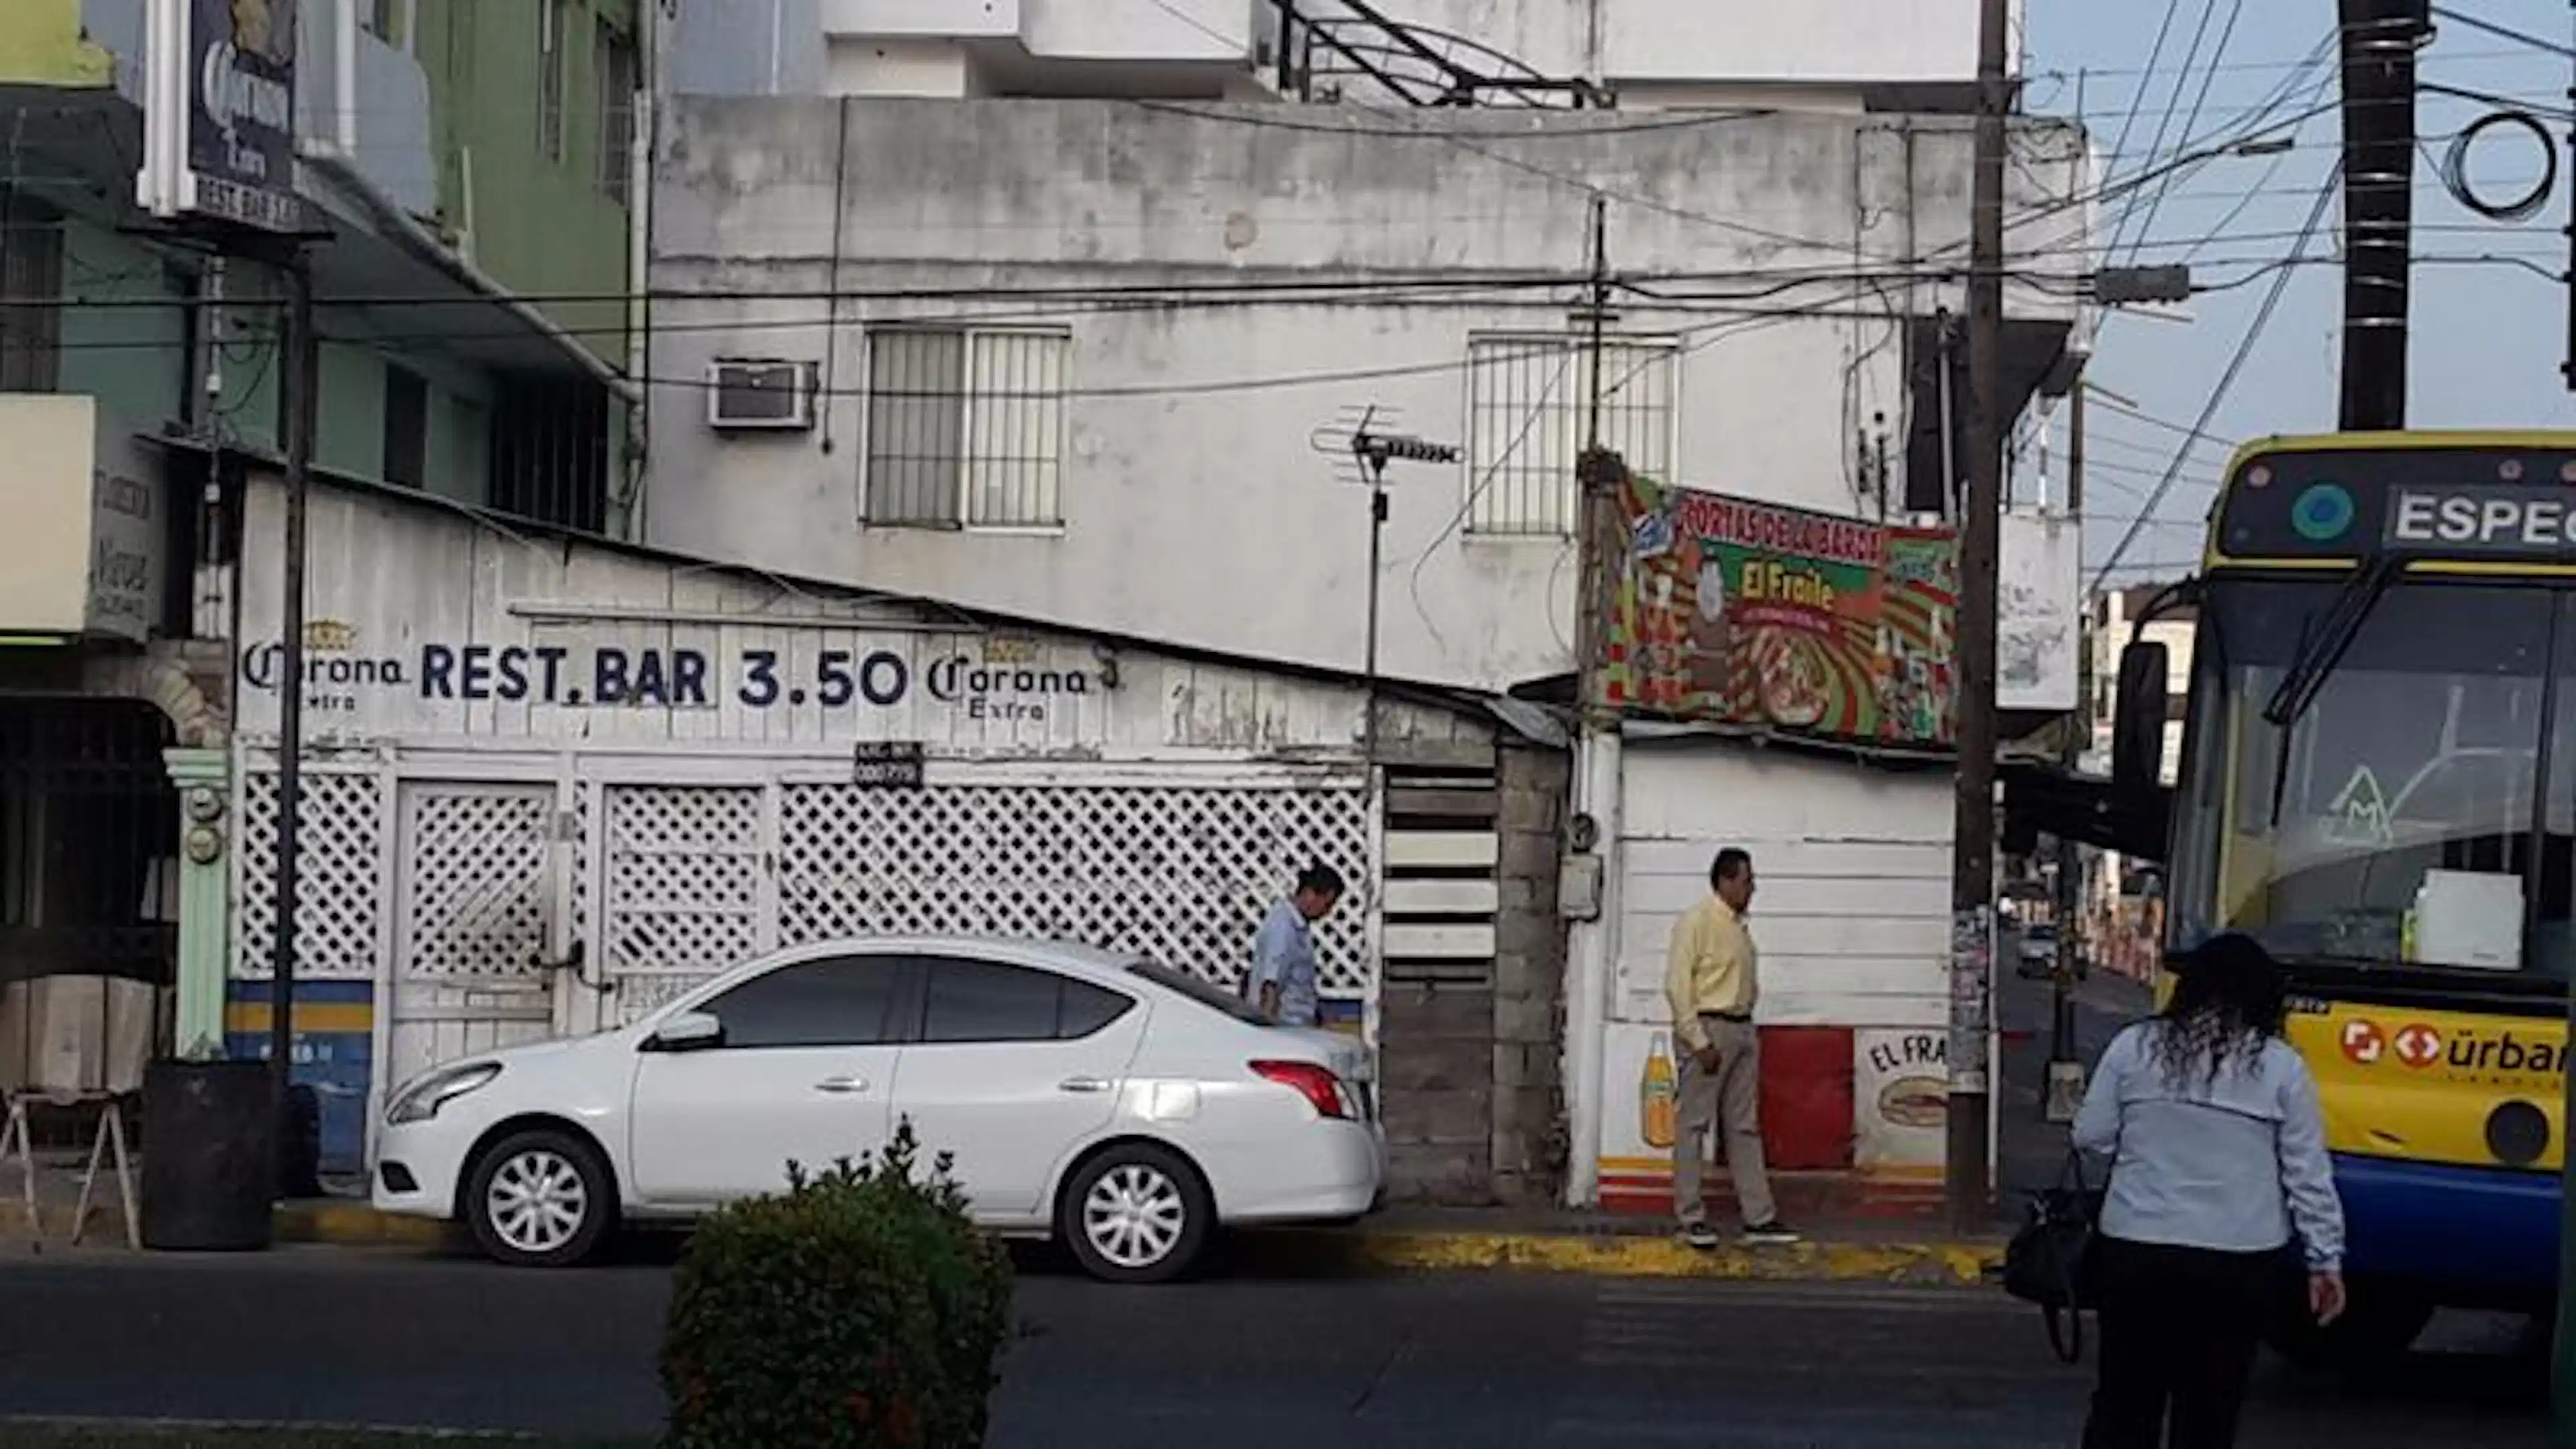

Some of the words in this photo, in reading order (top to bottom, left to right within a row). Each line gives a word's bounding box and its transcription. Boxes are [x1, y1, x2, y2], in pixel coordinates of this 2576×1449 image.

[2396, 493, 2576, 544] ESPE
[1741, 561, 1765, 598] El
[1766, 561, 1835, 611] Fraile
[243, 641, 411, 689] Crona
[596, 648, 705, 704] BAR
[739, 650, 909, 707] 3.50
[928, 653, 1088, 700] Corona
[1870, 1043, 1900, 1072] EL
[1903, 1035, 1947, 1063] FRA
